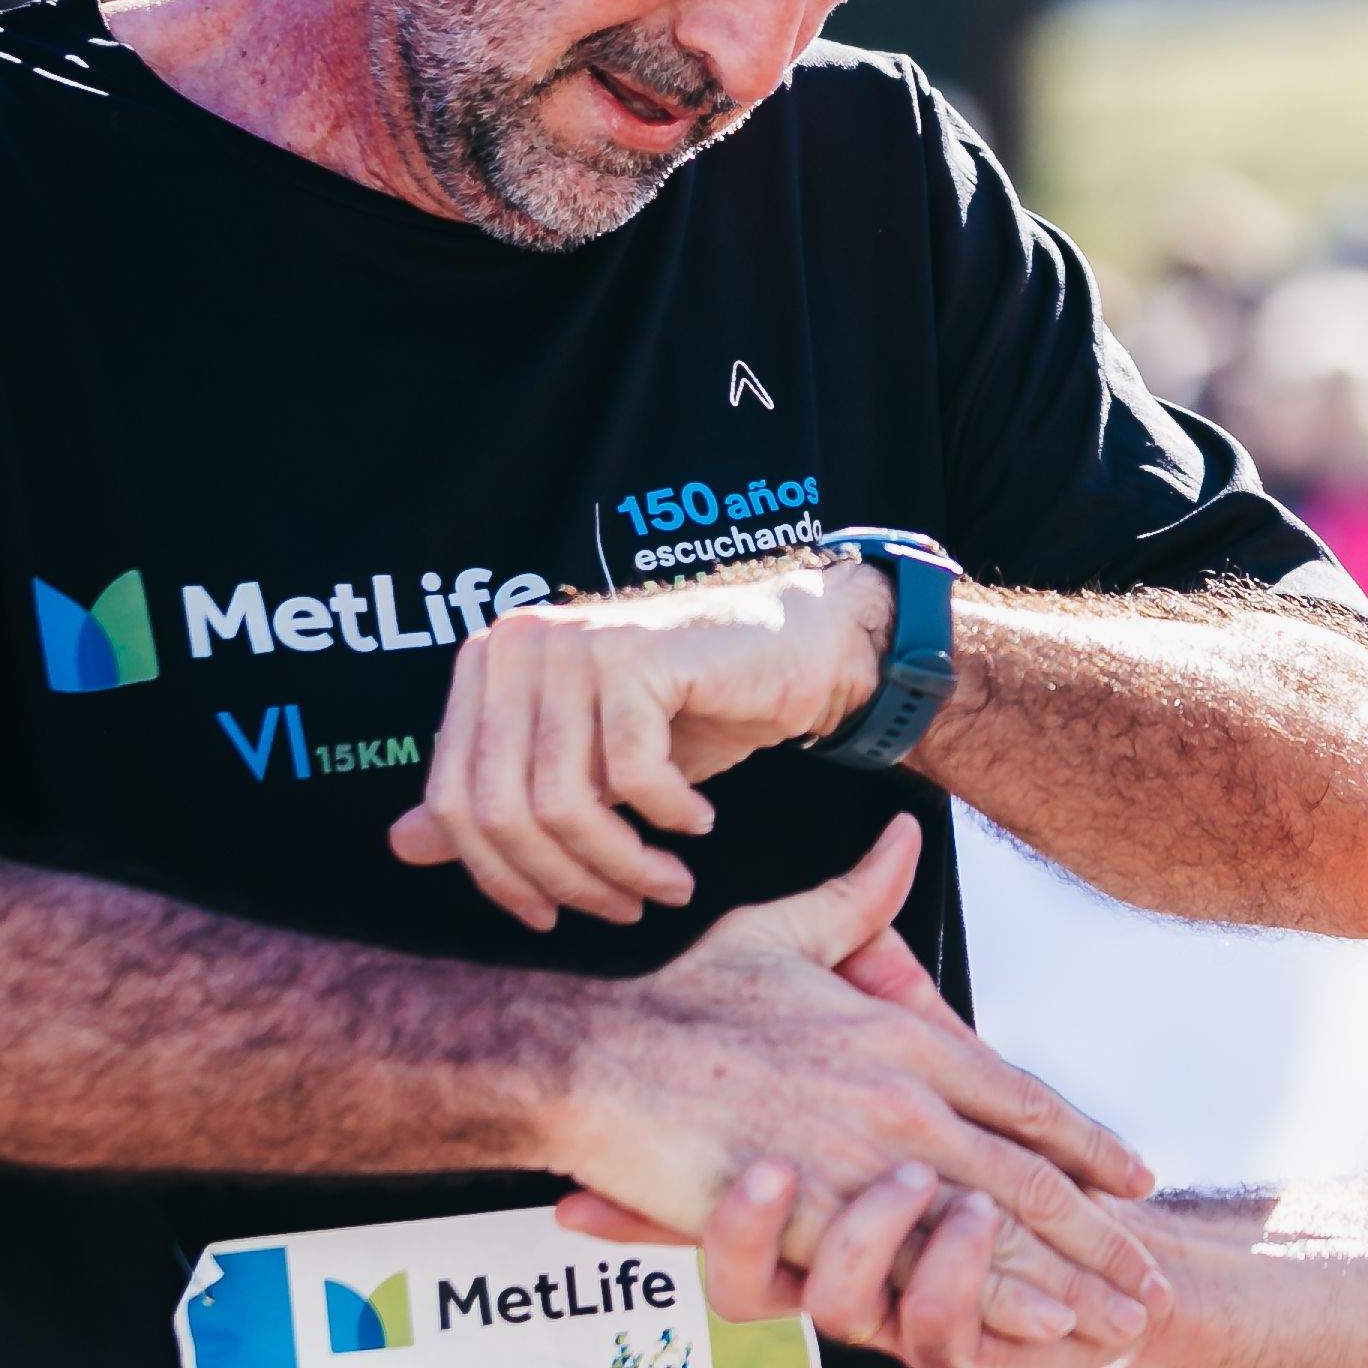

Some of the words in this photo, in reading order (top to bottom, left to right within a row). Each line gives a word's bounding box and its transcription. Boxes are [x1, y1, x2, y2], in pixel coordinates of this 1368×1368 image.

[618, 482, 718, 535] 150
[724, 477, 819, 520] años
[635, 511, 822, 571] escuchando
[216, 704, 312, 781] VI
[315, 736, 421, 774] 15KM
[438, 1259, 676, 1330] MetLife
